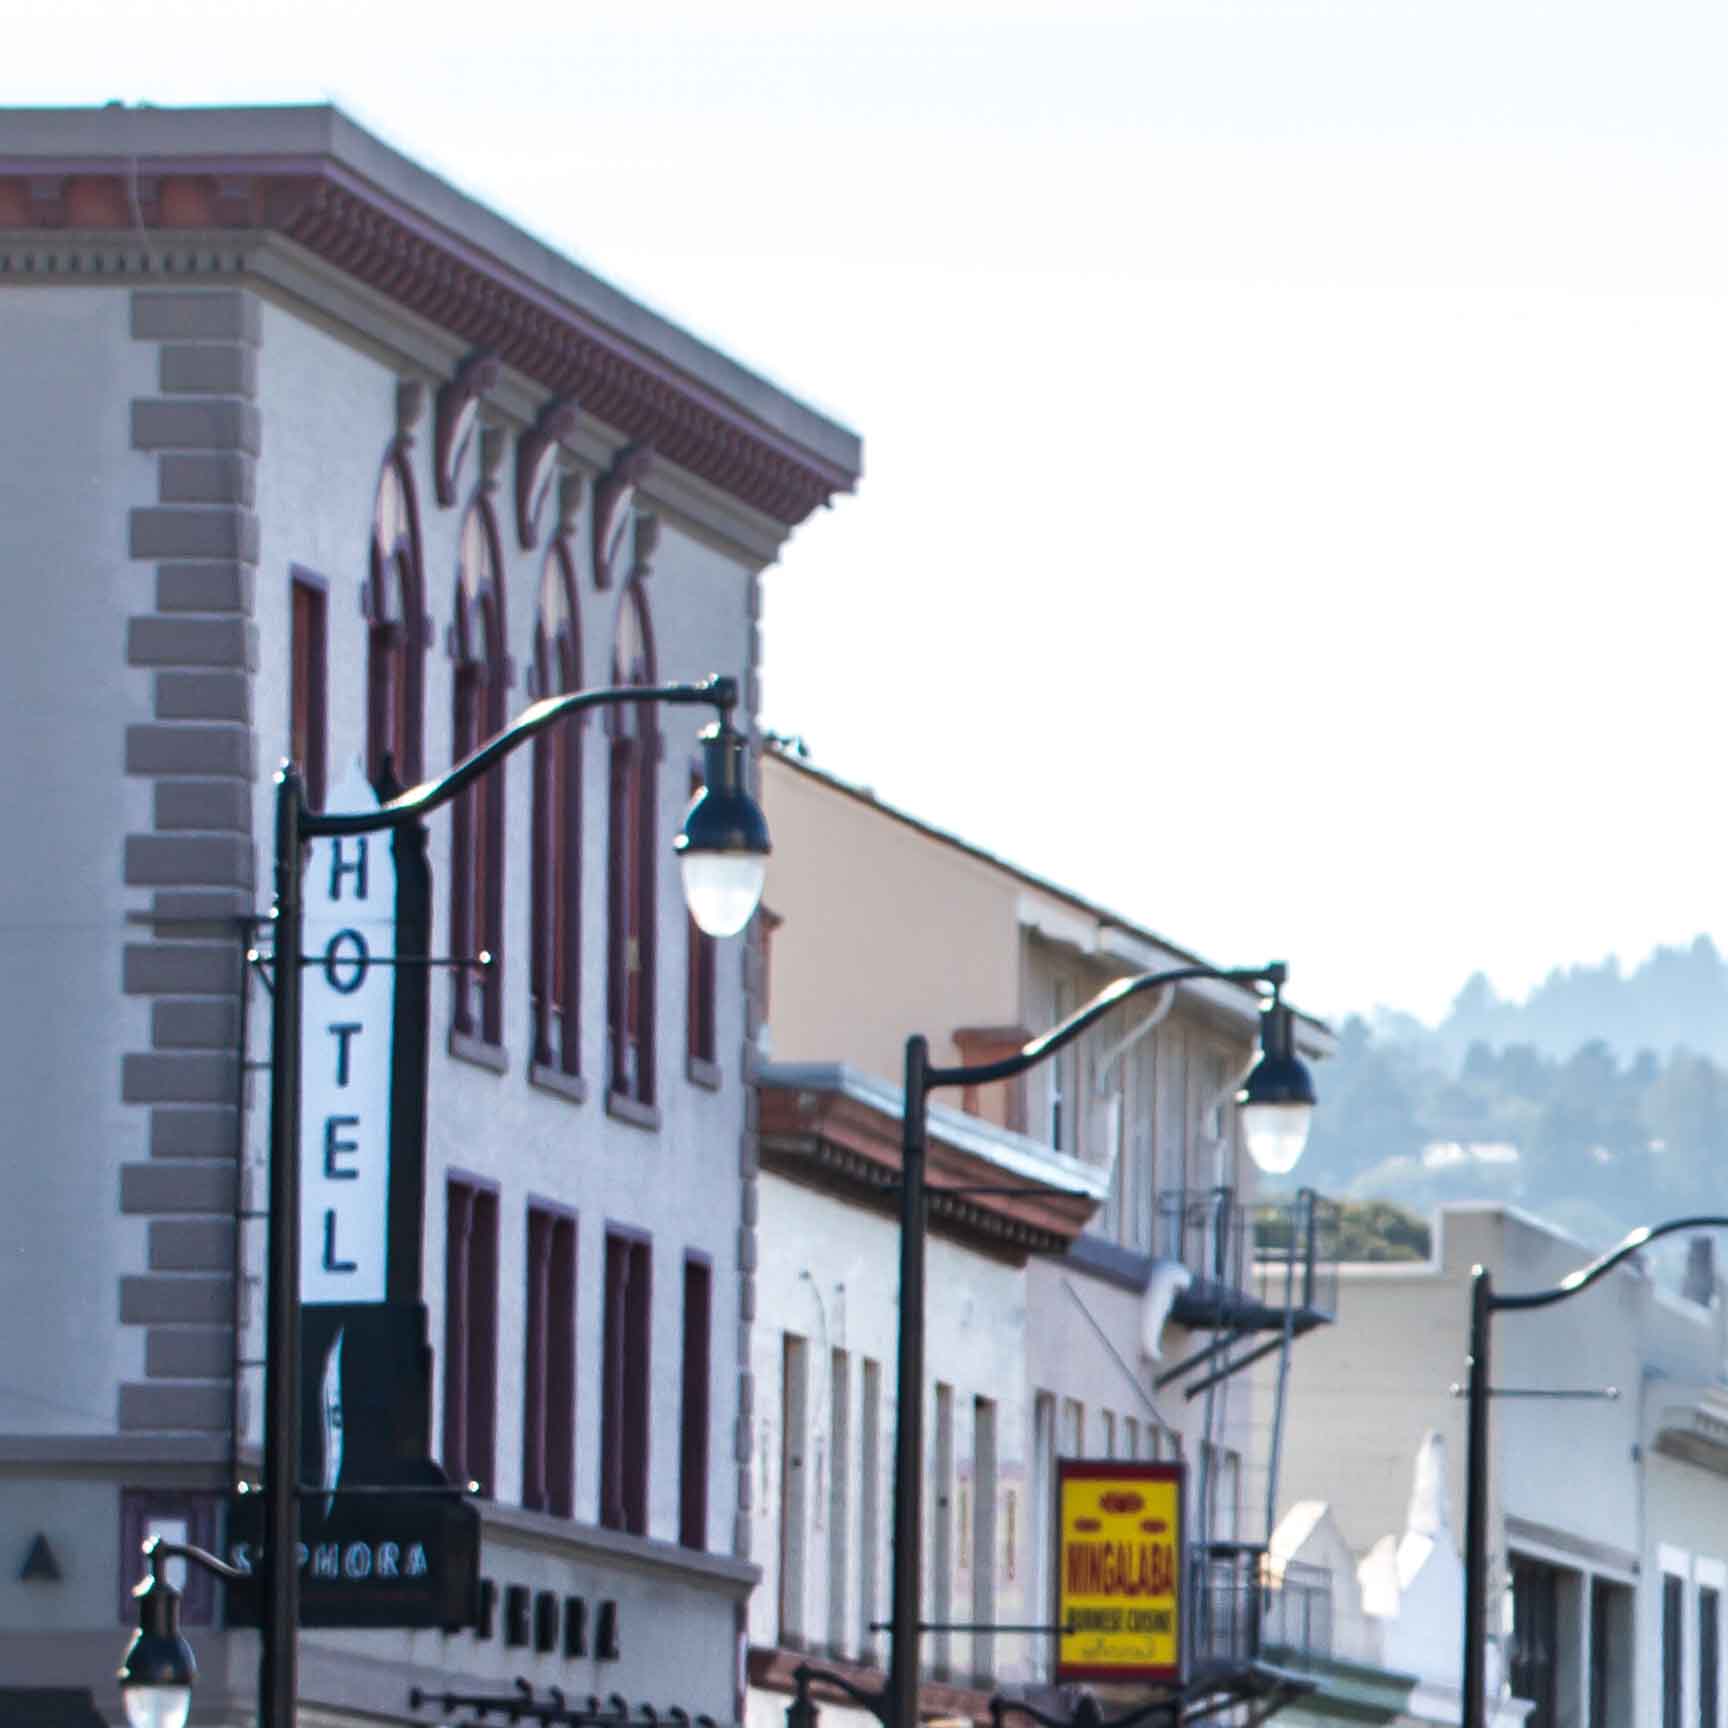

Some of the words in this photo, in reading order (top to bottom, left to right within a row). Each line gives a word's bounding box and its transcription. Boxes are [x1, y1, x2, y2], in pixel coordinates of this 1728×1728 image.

[322, 836, 370, 1273] HOTEL
[230, 1540, 429, 1579] SPHORA
[1067, 1541, 1174, 1597] MINGALABA
